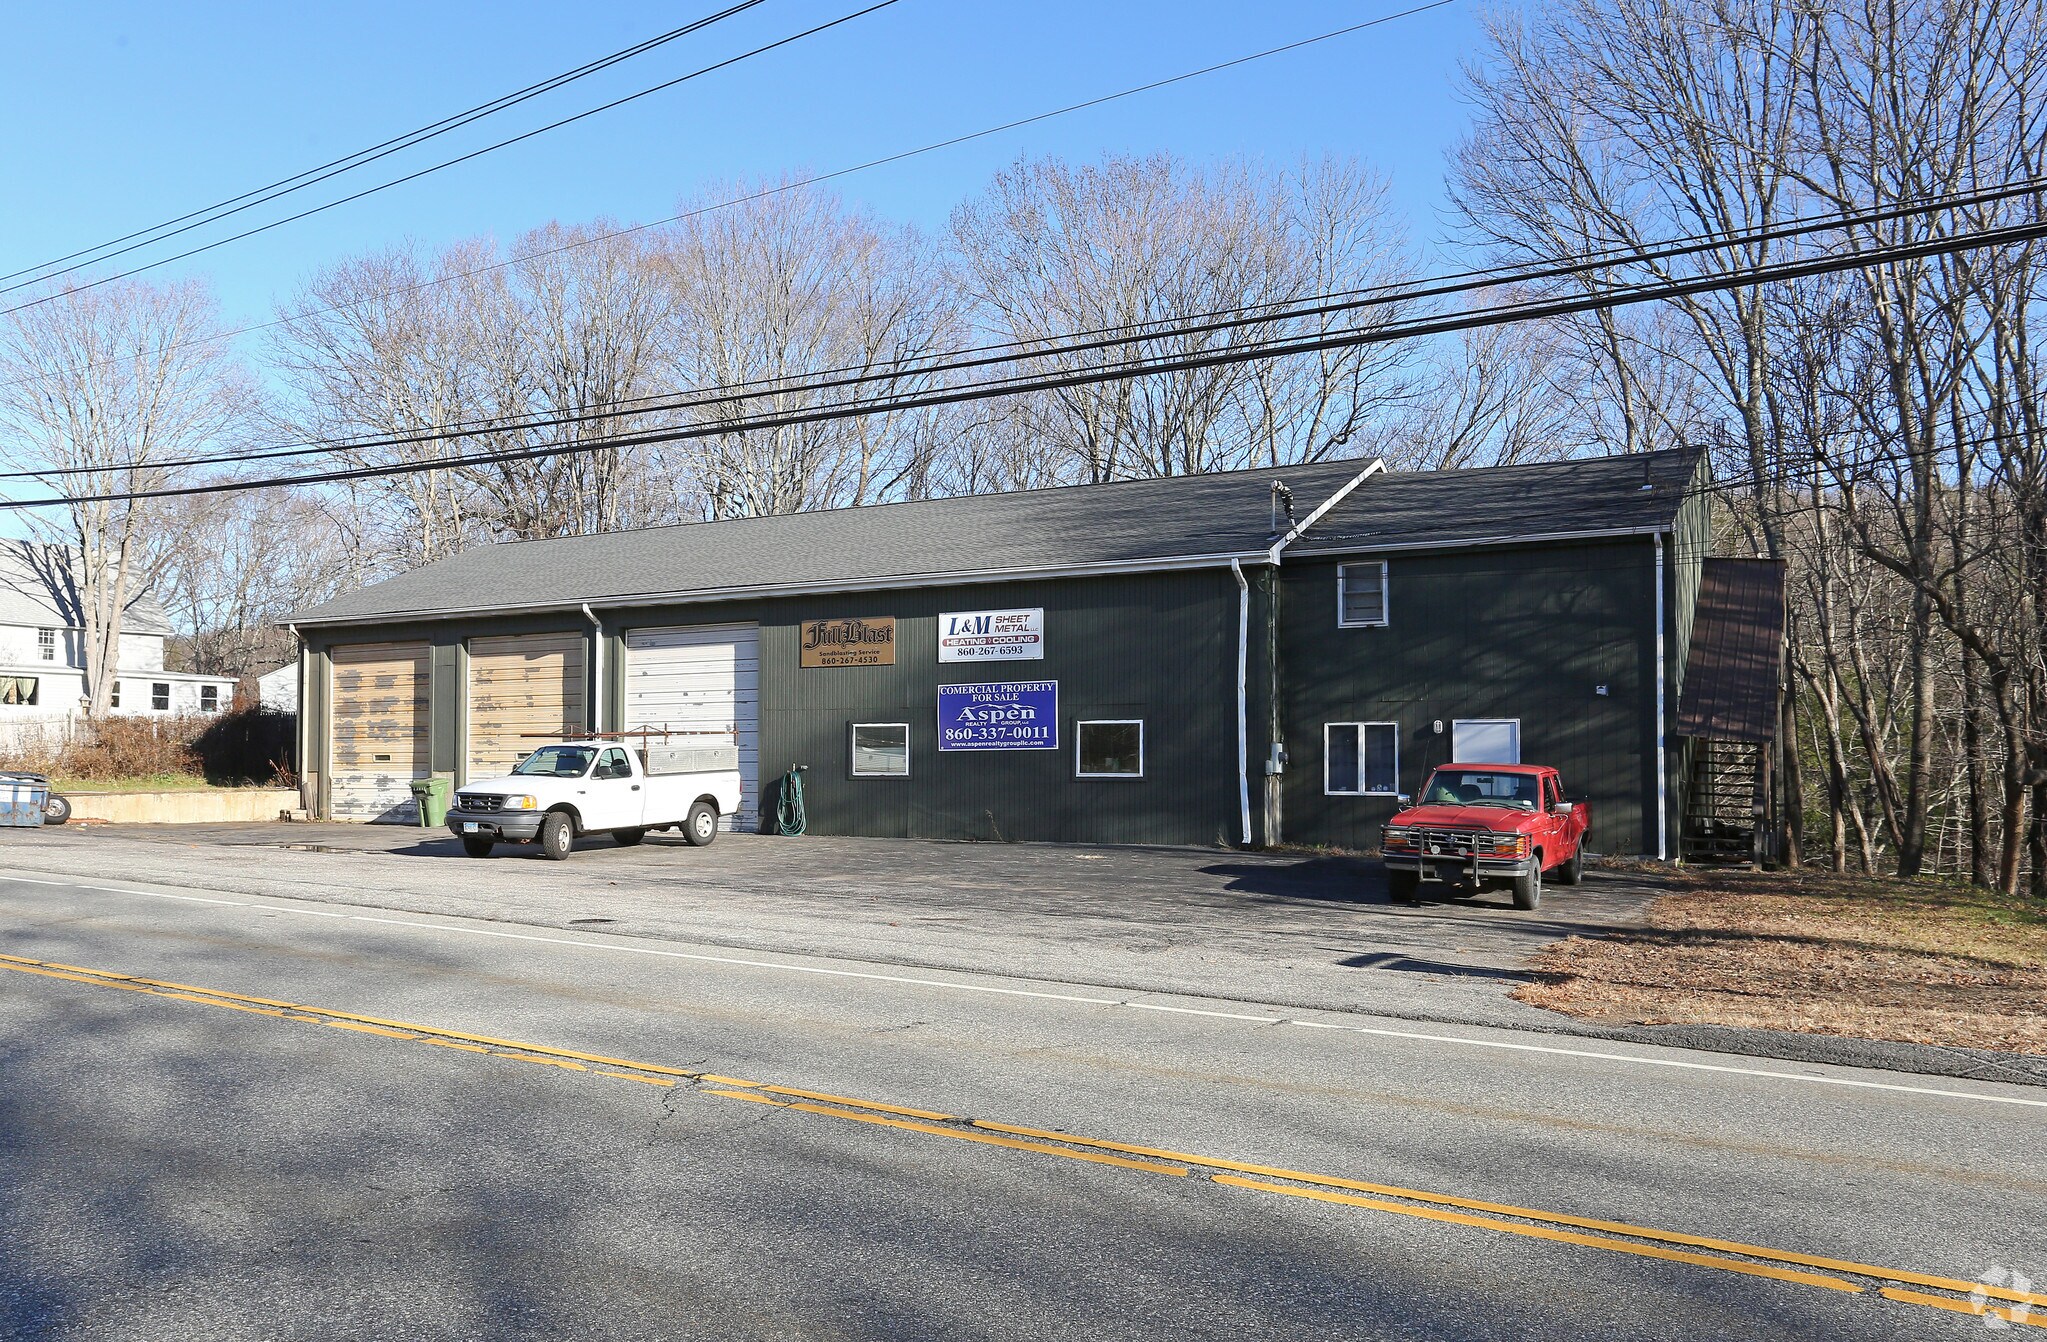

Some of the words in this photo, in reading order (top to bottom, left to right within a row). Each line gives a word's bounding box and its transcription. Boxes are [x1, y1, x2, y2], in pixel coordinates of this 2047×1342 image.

[948, 616, 992, 636] L&M
[996, 615, 1030, 623] SHEET
[995, 624, 1029, 633] METAL
[803, 620, 842, 650] Full
[842, 620, 894, 649] Blast
[946, 638, 986, 646] HEATING
[992, 636, 1034, 644] COOLING
[957, 646, 1023, 656] 860-267-6593
[940, 685, 998, 695] COMERCIAL
[1001, 683, 1054, 693] PROPERTY
[994, 693, 1019, 701] SALE
[956, 707, 1036, 724] Aspen
[945, 726, 1049, 740] 860-337-0011
